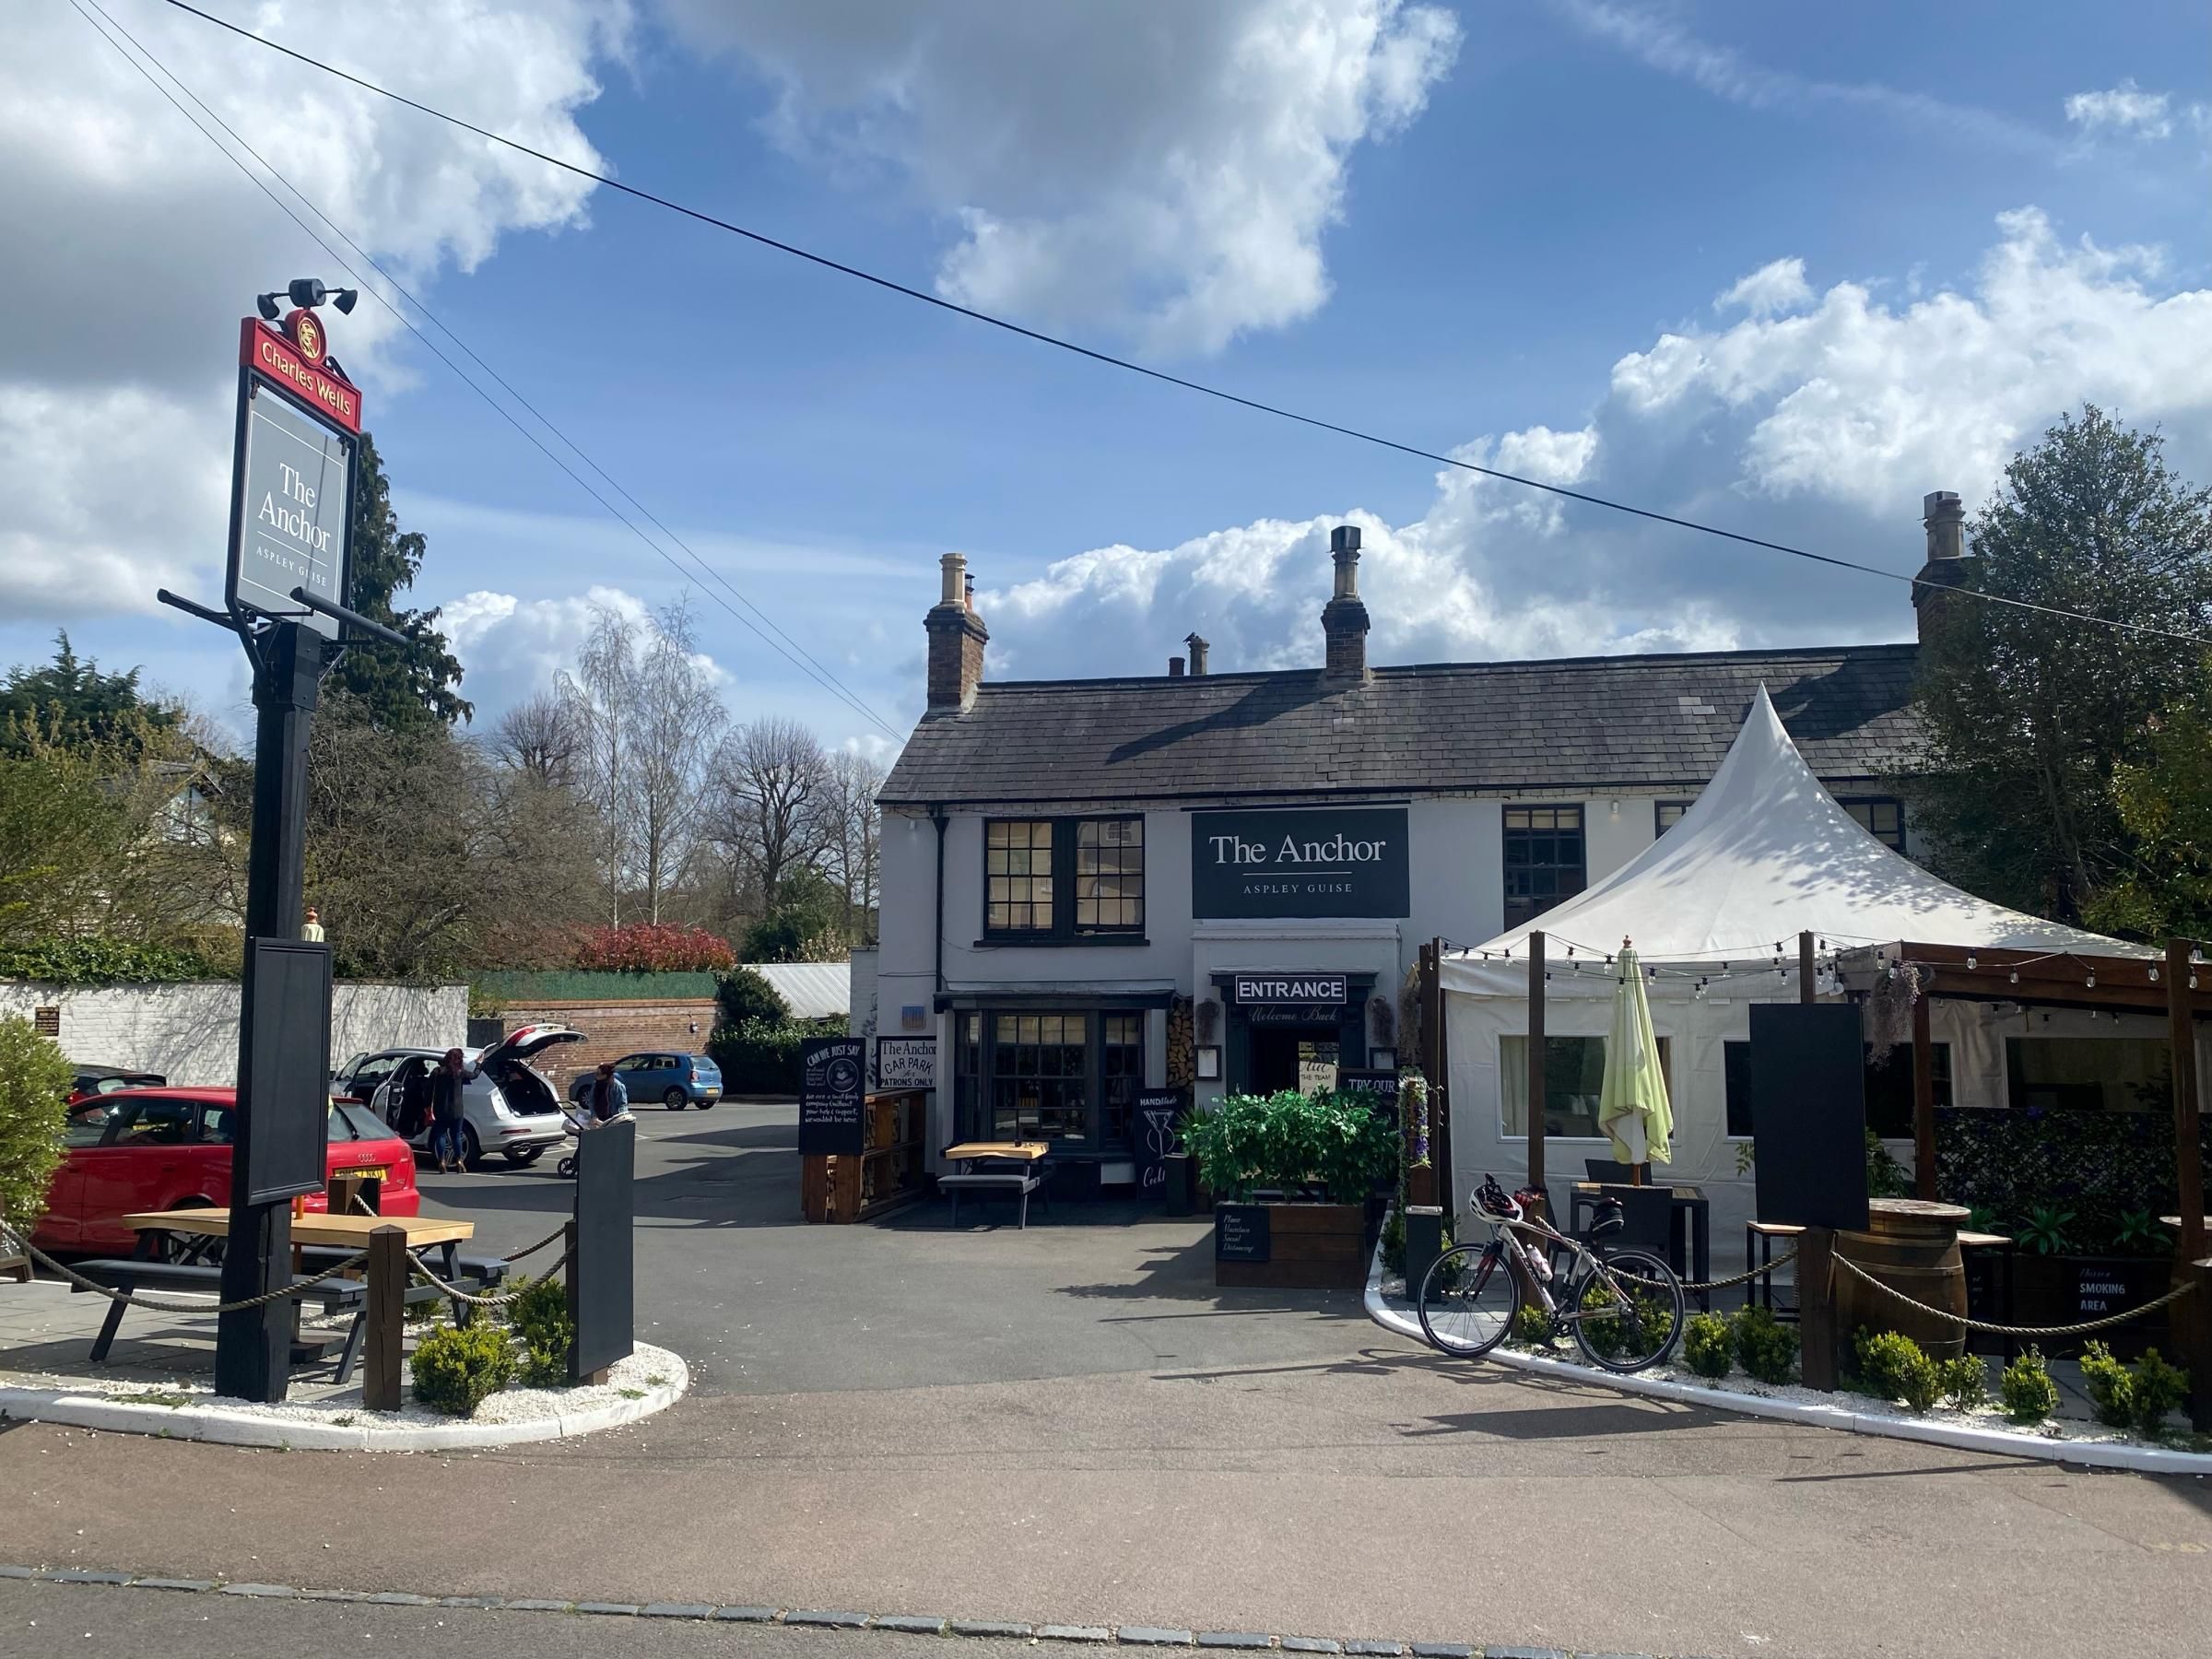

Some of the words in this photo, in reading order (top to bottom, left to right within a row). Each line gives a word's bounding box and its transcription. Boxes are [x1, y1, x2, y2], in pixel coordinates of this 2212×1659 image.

[261, 341, 313, 392] Charles
[315, 379, 351, 418] Wells
[279, 462, 316, 509] The
[257, 490, 331, 553] Anchor
[256, 545, 296, 572] ASPLEY
[1208, 834, 1267, 864] The
[1275, 832, 1386, 864] Anchor
[1243, 884, 1300, 894] ASPLEY
[1307, 883, 1353, 893] GUISE
[1238, 981, 1344, 998] ENTRANCE
[1248, 1005, 1298, 1022] Welcome
[1301, 1005, 1337, 1021] Back
[806, 1052, 820, 1067] CAN
[818, 1047, 830, 1061] WE
[831, 1044, 847, 1057] JUST
[847, 1045, 861, 1056] SAY
[882, 1041, 902, 1055] The
[884, 1057, 906, 1075] CAR
[908, 1057, 934, 1076] PARK
[881, 1077, 912, 1087] PATRONS
[914, 1077, 934, 1087] ONLY
[1300, 1073, 1312, 1081] THE
[1348, 1078, 1372, 1092] TRY
[1373, 1079, 1397, 1093] OUR
[2079, 1283, 2126, 1295] SMOKING
[2080, 1300, 2108, 1312] AREA
